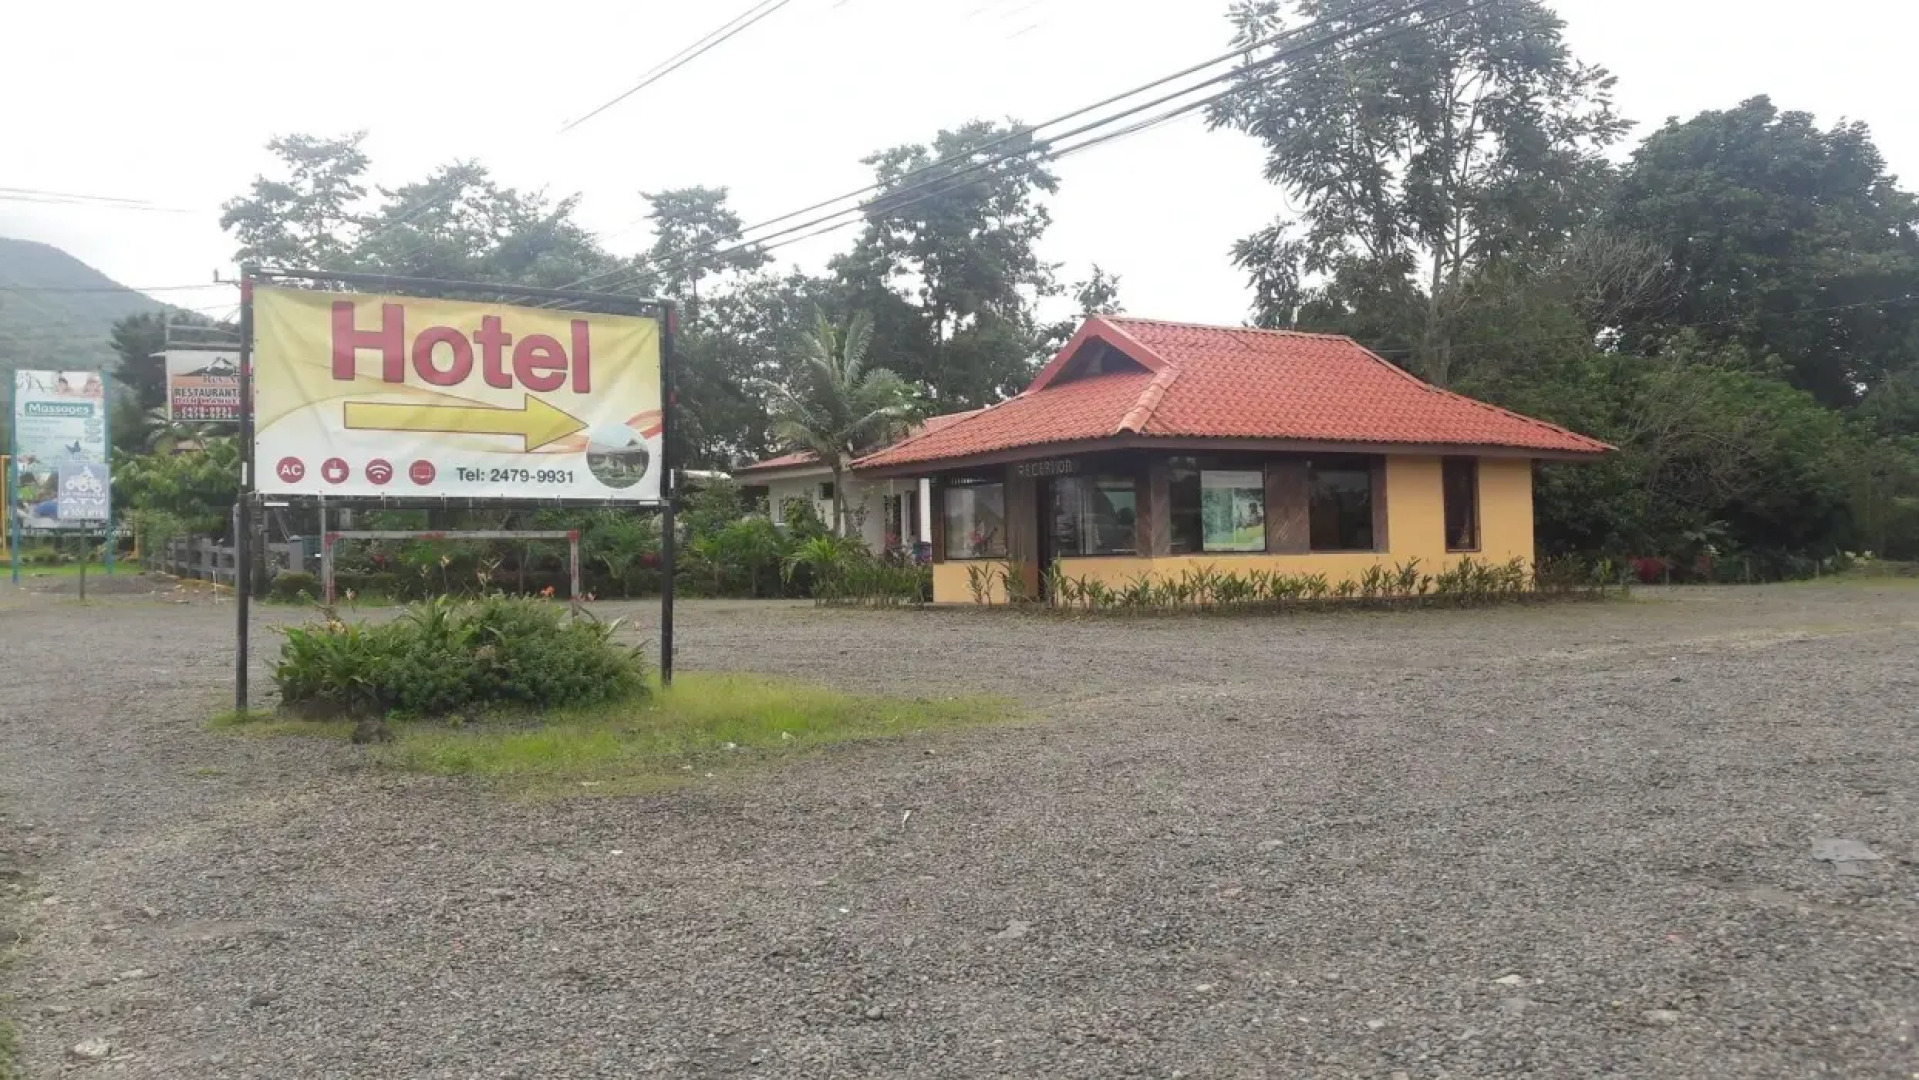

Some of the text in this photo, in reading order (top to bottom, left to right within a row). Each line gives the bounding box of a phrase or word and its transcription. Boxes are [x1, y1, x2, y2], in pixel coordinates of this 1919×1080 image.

[331, 300, 591, 393] Hotel
[28, 402, 90, 414] Massages
[280, 463, 302, 477] AC
[456, 466, 574, 484] Tel: 2479-9931
